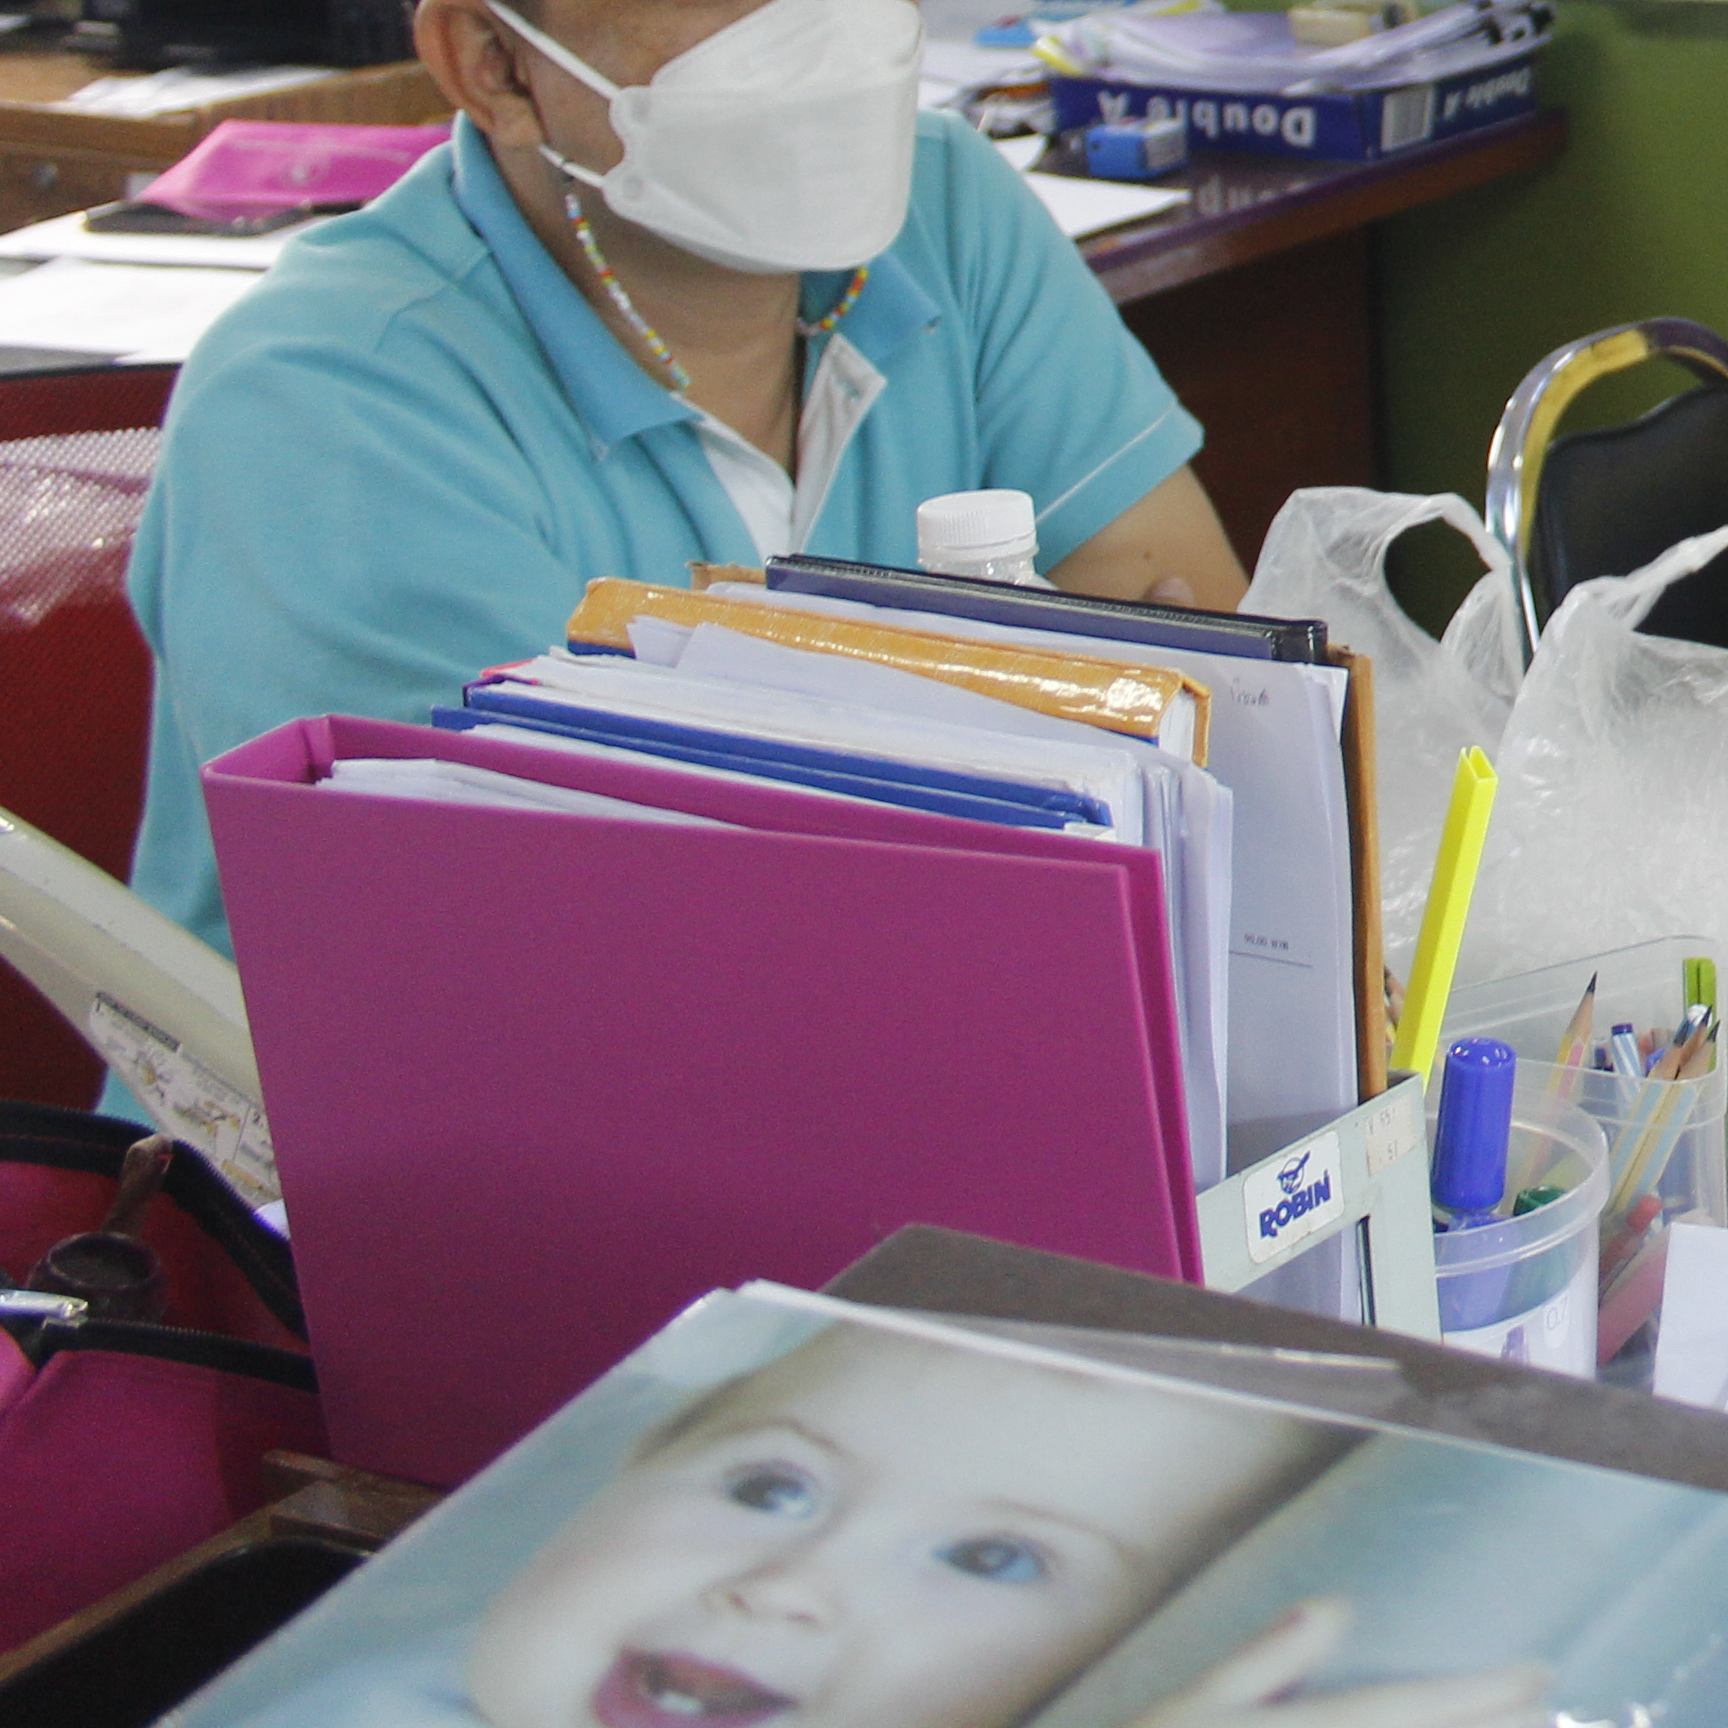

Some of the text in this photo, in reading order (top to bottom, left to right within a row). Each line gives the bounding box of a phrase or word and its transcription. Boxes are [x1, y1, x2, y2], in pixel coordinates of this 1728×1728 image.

[1097, 90, 1318, 149] Double A
[1442, 92, 1463, 120] A
[1259, 1169, 1331, 1239] ROBIN
